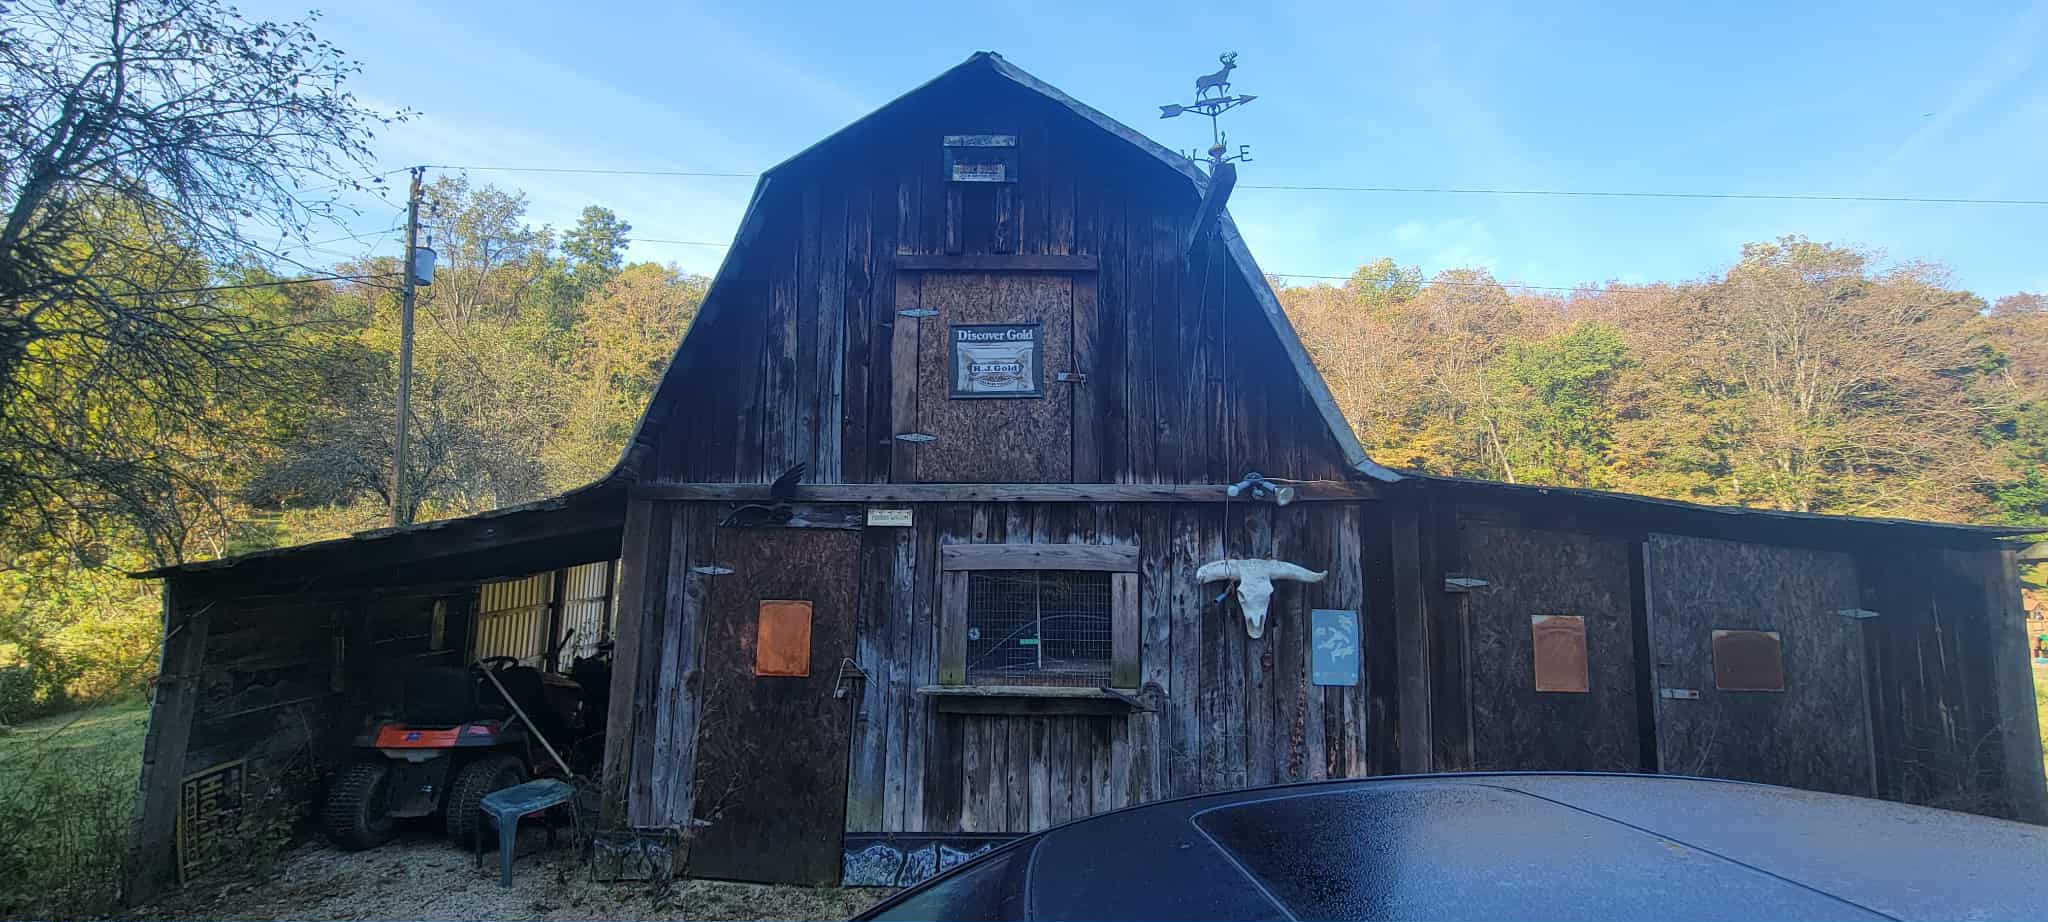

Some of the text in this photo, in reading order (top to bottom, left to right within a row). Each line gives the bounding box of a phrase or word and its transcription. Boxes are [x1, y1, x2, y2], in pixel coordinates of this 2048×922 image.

[1239, 145, 1253, 162] E
[957, 328, 1034, 341] Discover Gold
